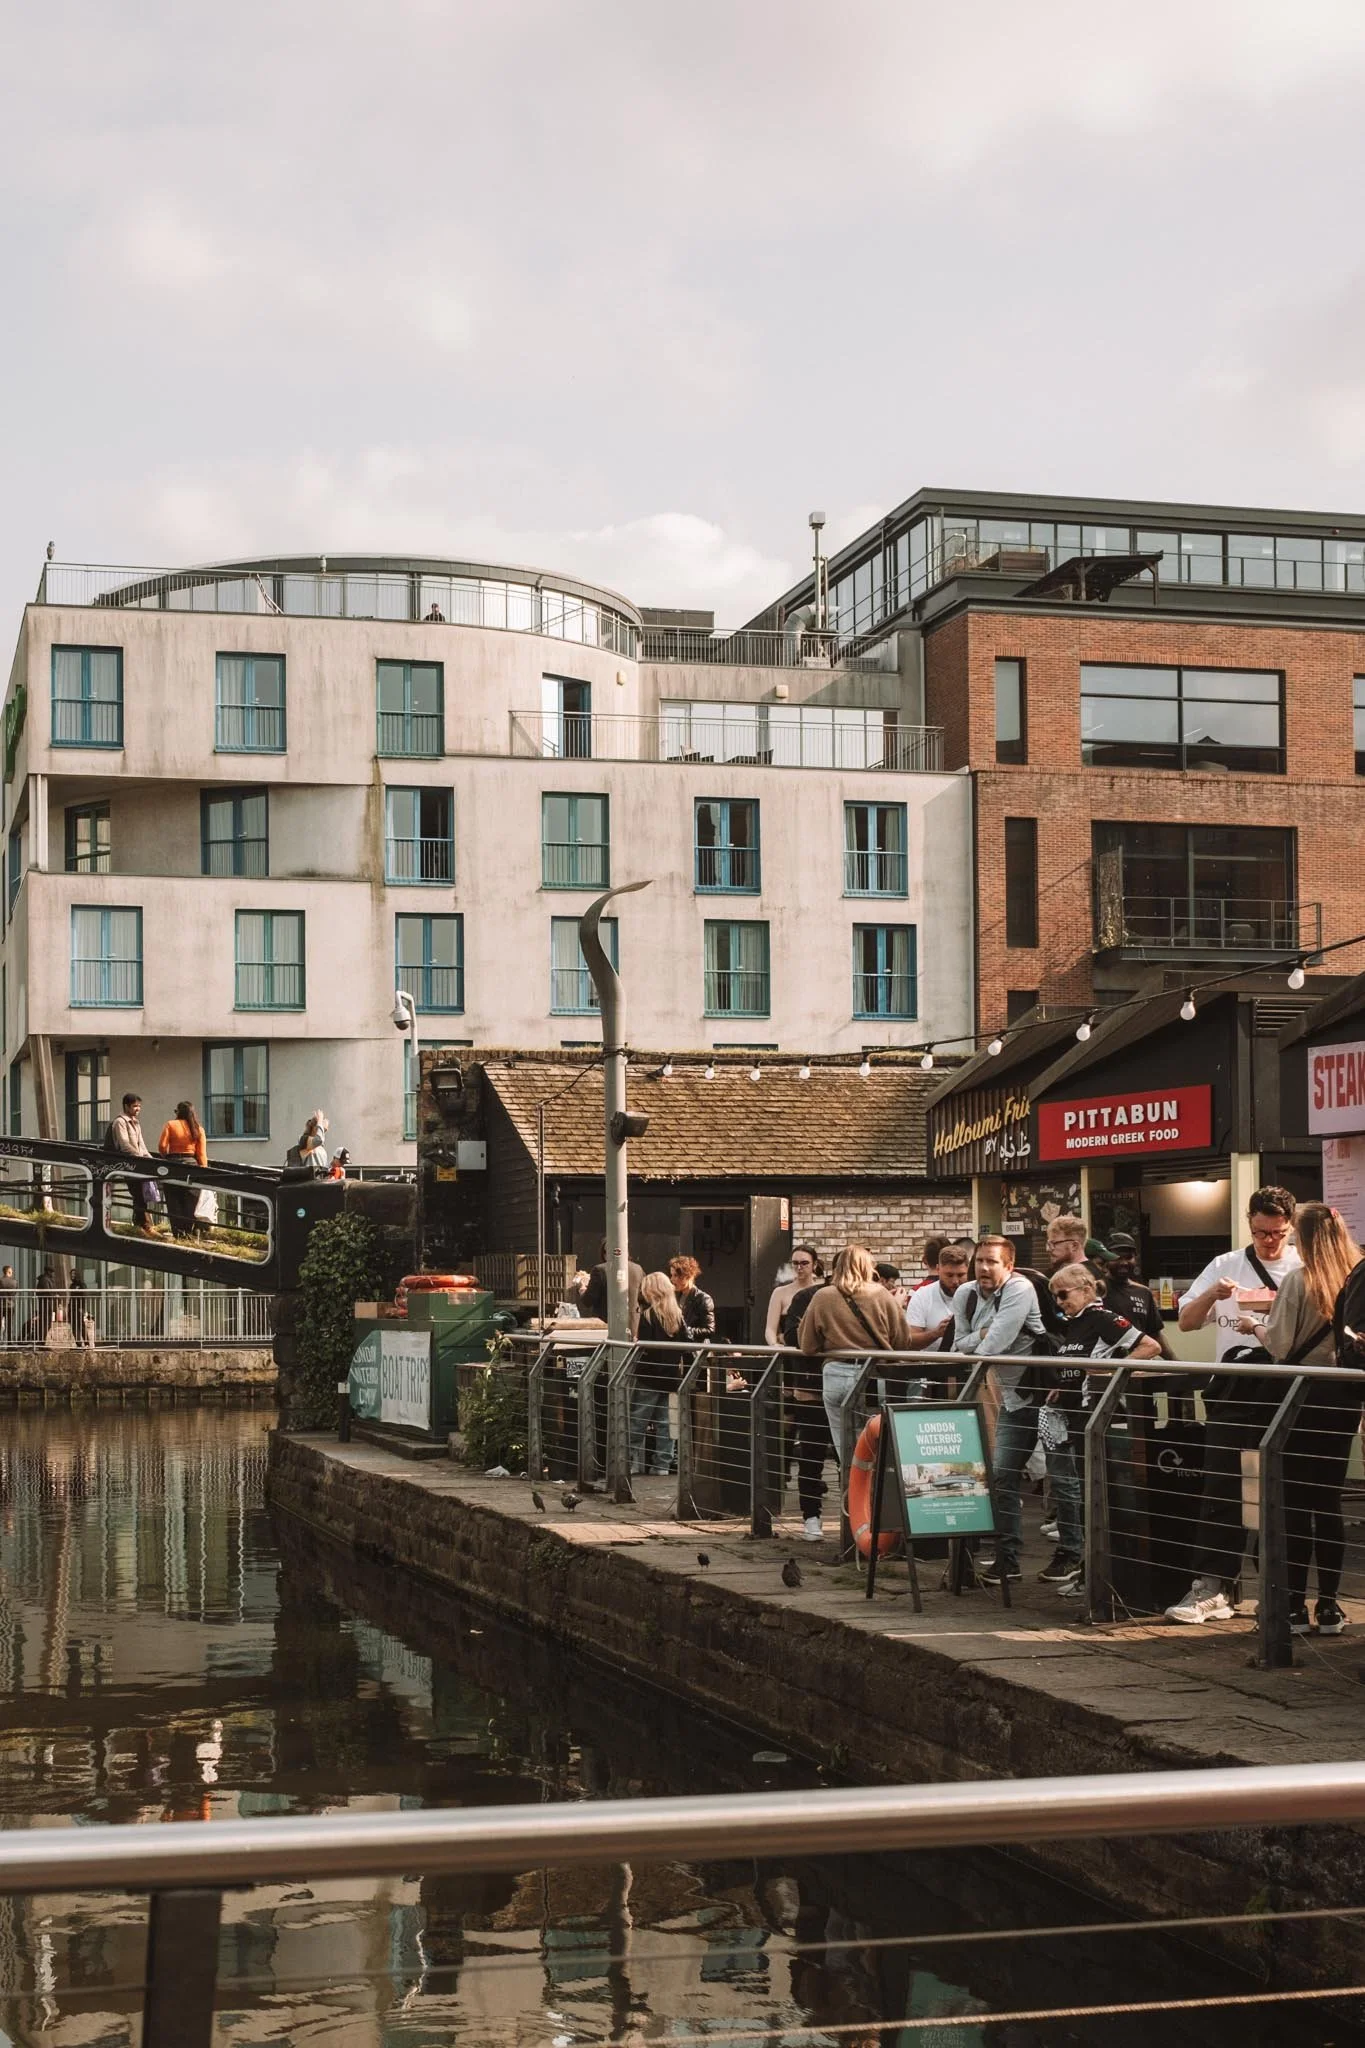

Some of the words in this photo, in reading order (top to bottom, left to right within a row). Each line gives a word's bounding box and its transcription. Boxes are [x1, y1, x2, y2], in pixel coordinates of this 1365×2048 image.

[1064, 1100, 1178, 1132] PITTABUN
[933, 1108, 1002, 1159] Halloumi
[1066, 1134, 1109, 1149] MODERN
[1111, 1131, 1145, 1145] GREEK
[1149, 1128, 1179, 1141] FOOD
[984, 1136, 998, 1156] BY
[1005, 1224, 1021, 1233] ORDER
[382, 1355, 402, 1400] BOAT
[918, 1422, 956, 1433] LONDON
[916, 1433, 963, 1445] WATERBUS
[920, 1445, 961, 1456] COMPANY
